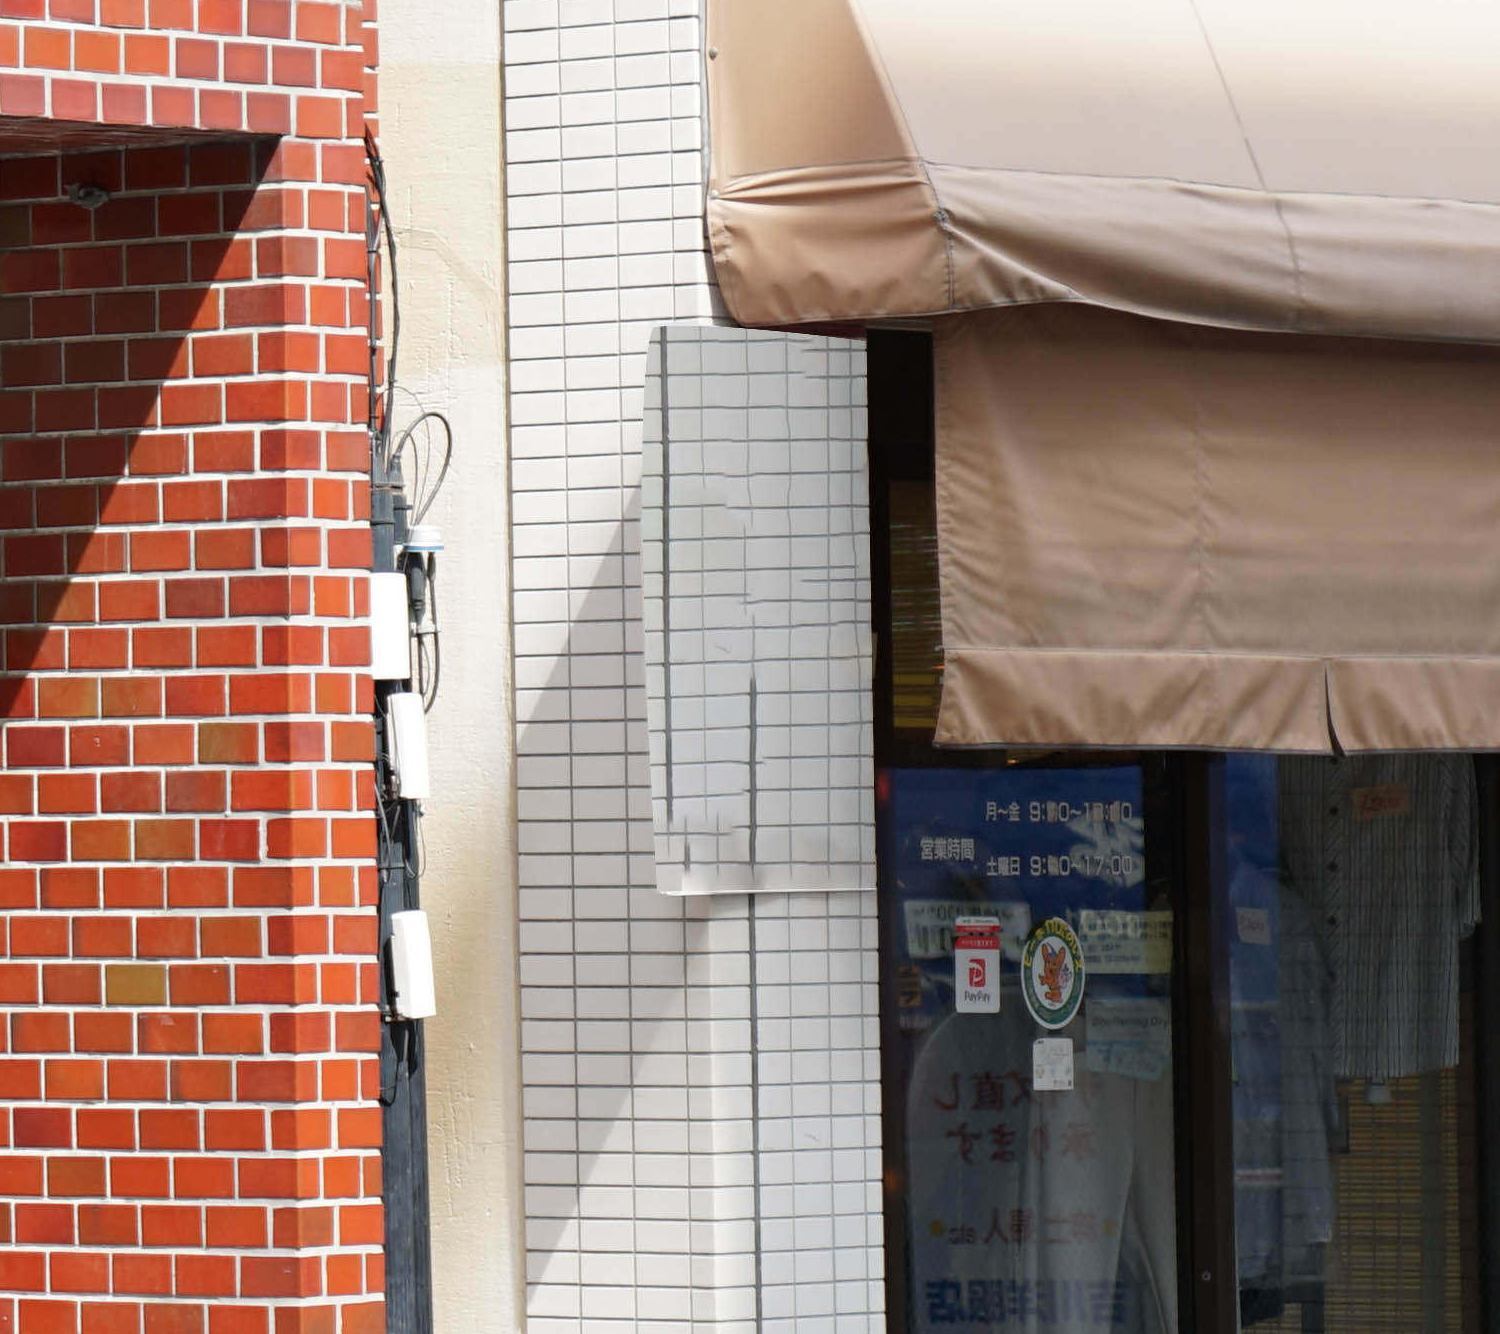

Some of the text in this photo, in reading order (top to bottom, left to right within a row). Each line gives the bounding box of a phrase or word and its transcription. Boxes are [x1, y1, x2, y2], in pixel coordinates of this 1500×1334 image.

[920, 836, 975, 861] 営業時間
[964, 990, 991, 1004] PayPay
